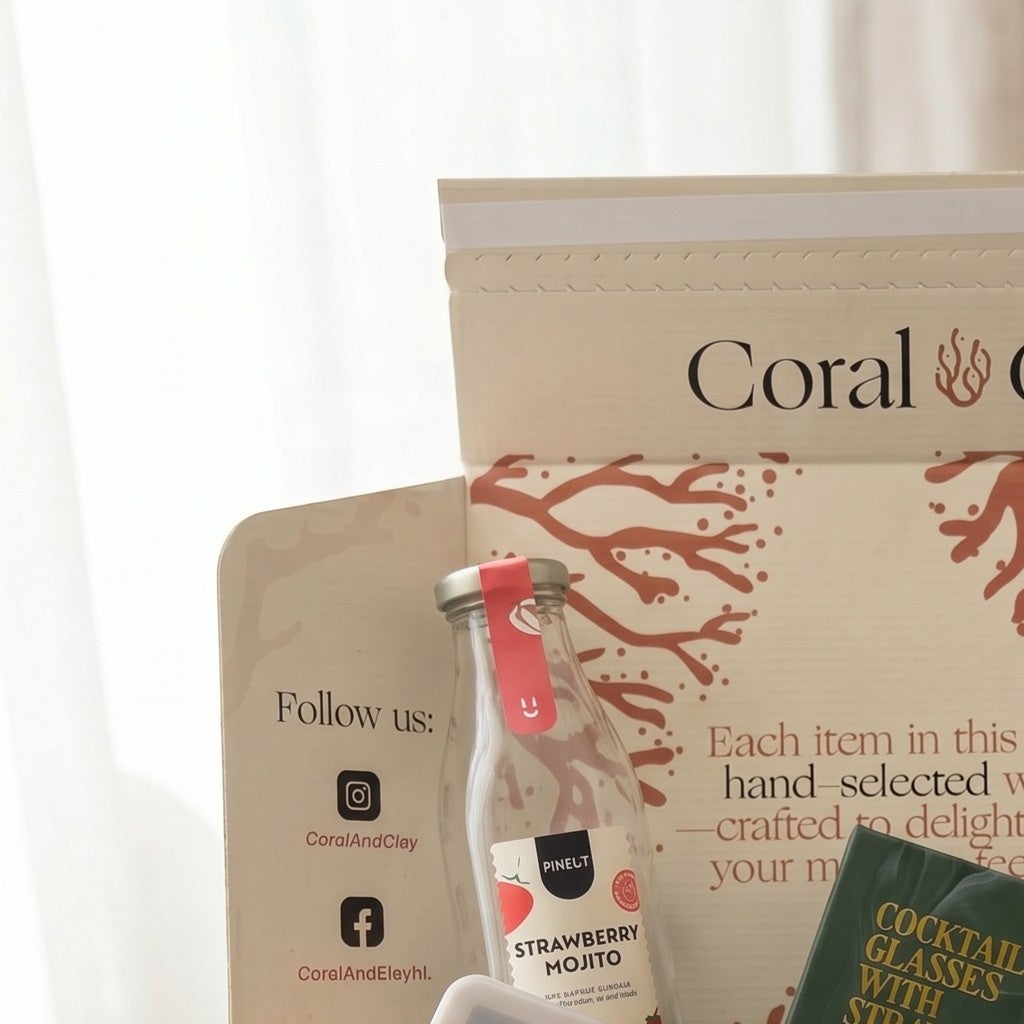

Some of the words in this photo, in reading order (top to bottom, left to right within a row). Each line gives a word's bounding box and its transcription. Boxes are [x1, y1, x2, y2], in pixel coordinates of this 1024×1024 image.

[688, 327, 916, 411] Coral
[276, 690, 382, 730] Follow
[393, 708, 434, 734] us:
[708, 722, 800, 758] Each
[814, 723, 893, 757] item
[907, 722, 941, 756] in
[954, 718, 1018, 754] this
[306, 831, 418, 853] CoralAndClay
[709, 855, 794, 891] your
[514, 924, 639, 958] STRAWBERRY
[545, 949, 622, 976] MOJITO
[865, 934, 1004, 1002] GLASSES
[859, 963, 945, 1019] WITH
